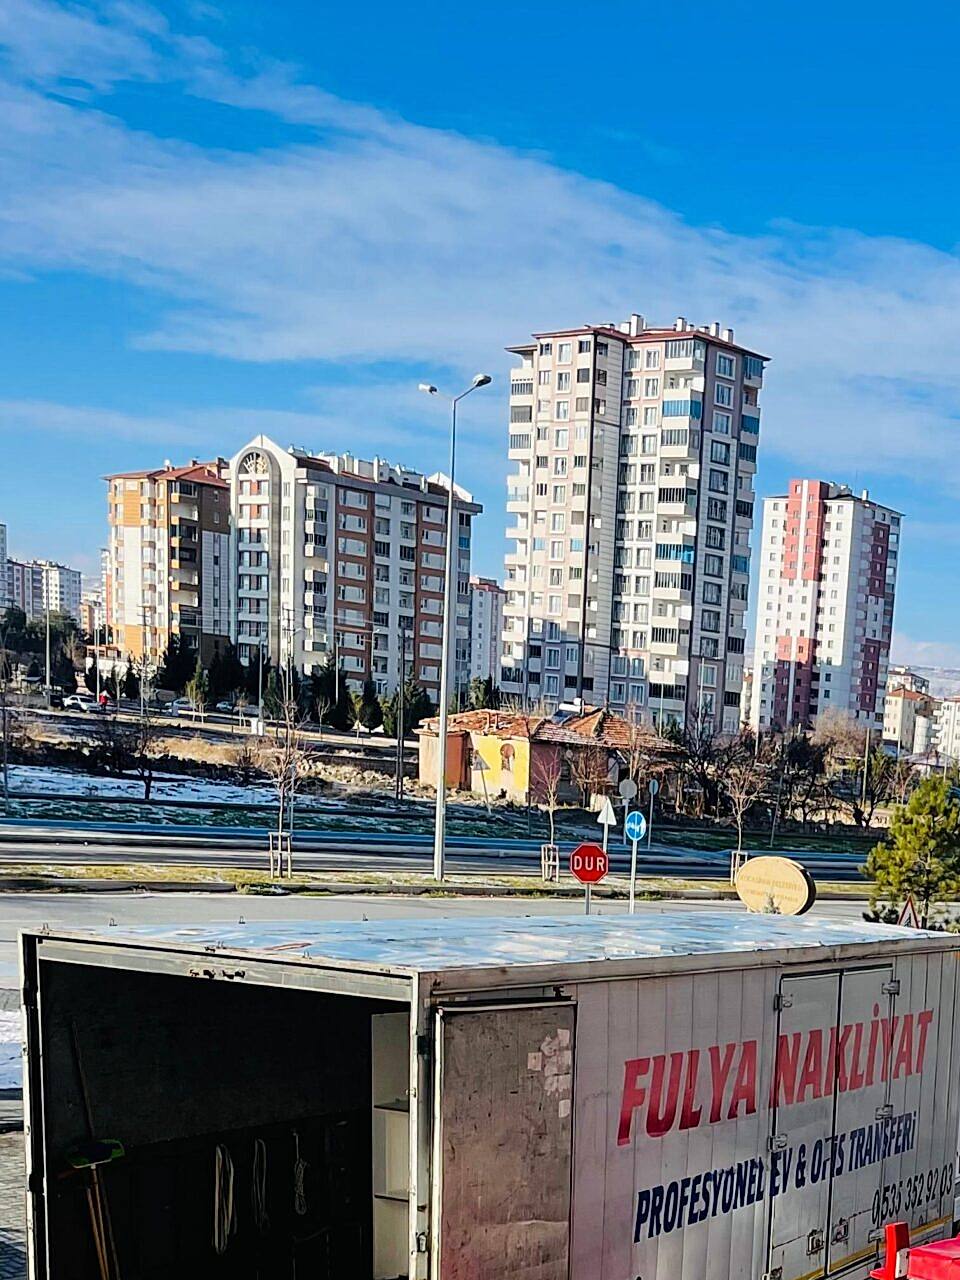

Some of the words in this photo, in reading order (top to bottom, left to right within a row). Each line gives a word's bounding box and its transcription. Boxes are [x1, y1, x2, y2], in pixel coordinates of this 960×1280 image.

[574, 856, 605, 872] DUR
[616, 1039, 758, 1146] FULYA
[769, 1003, 934, 1108] NAKLİYAT
[634, 1156, 765, 1244] PROFESYONEL
[770, 1147, 793, 1197] EV
[795, 1143, 807, 1188] &
[849, 1111, 917, 1172] TRANSFERİ
[905, 1173, 924, 1212] 352
[926, 1168, 939, 1203] 92
[940, 1163, 953, 1198] 03
